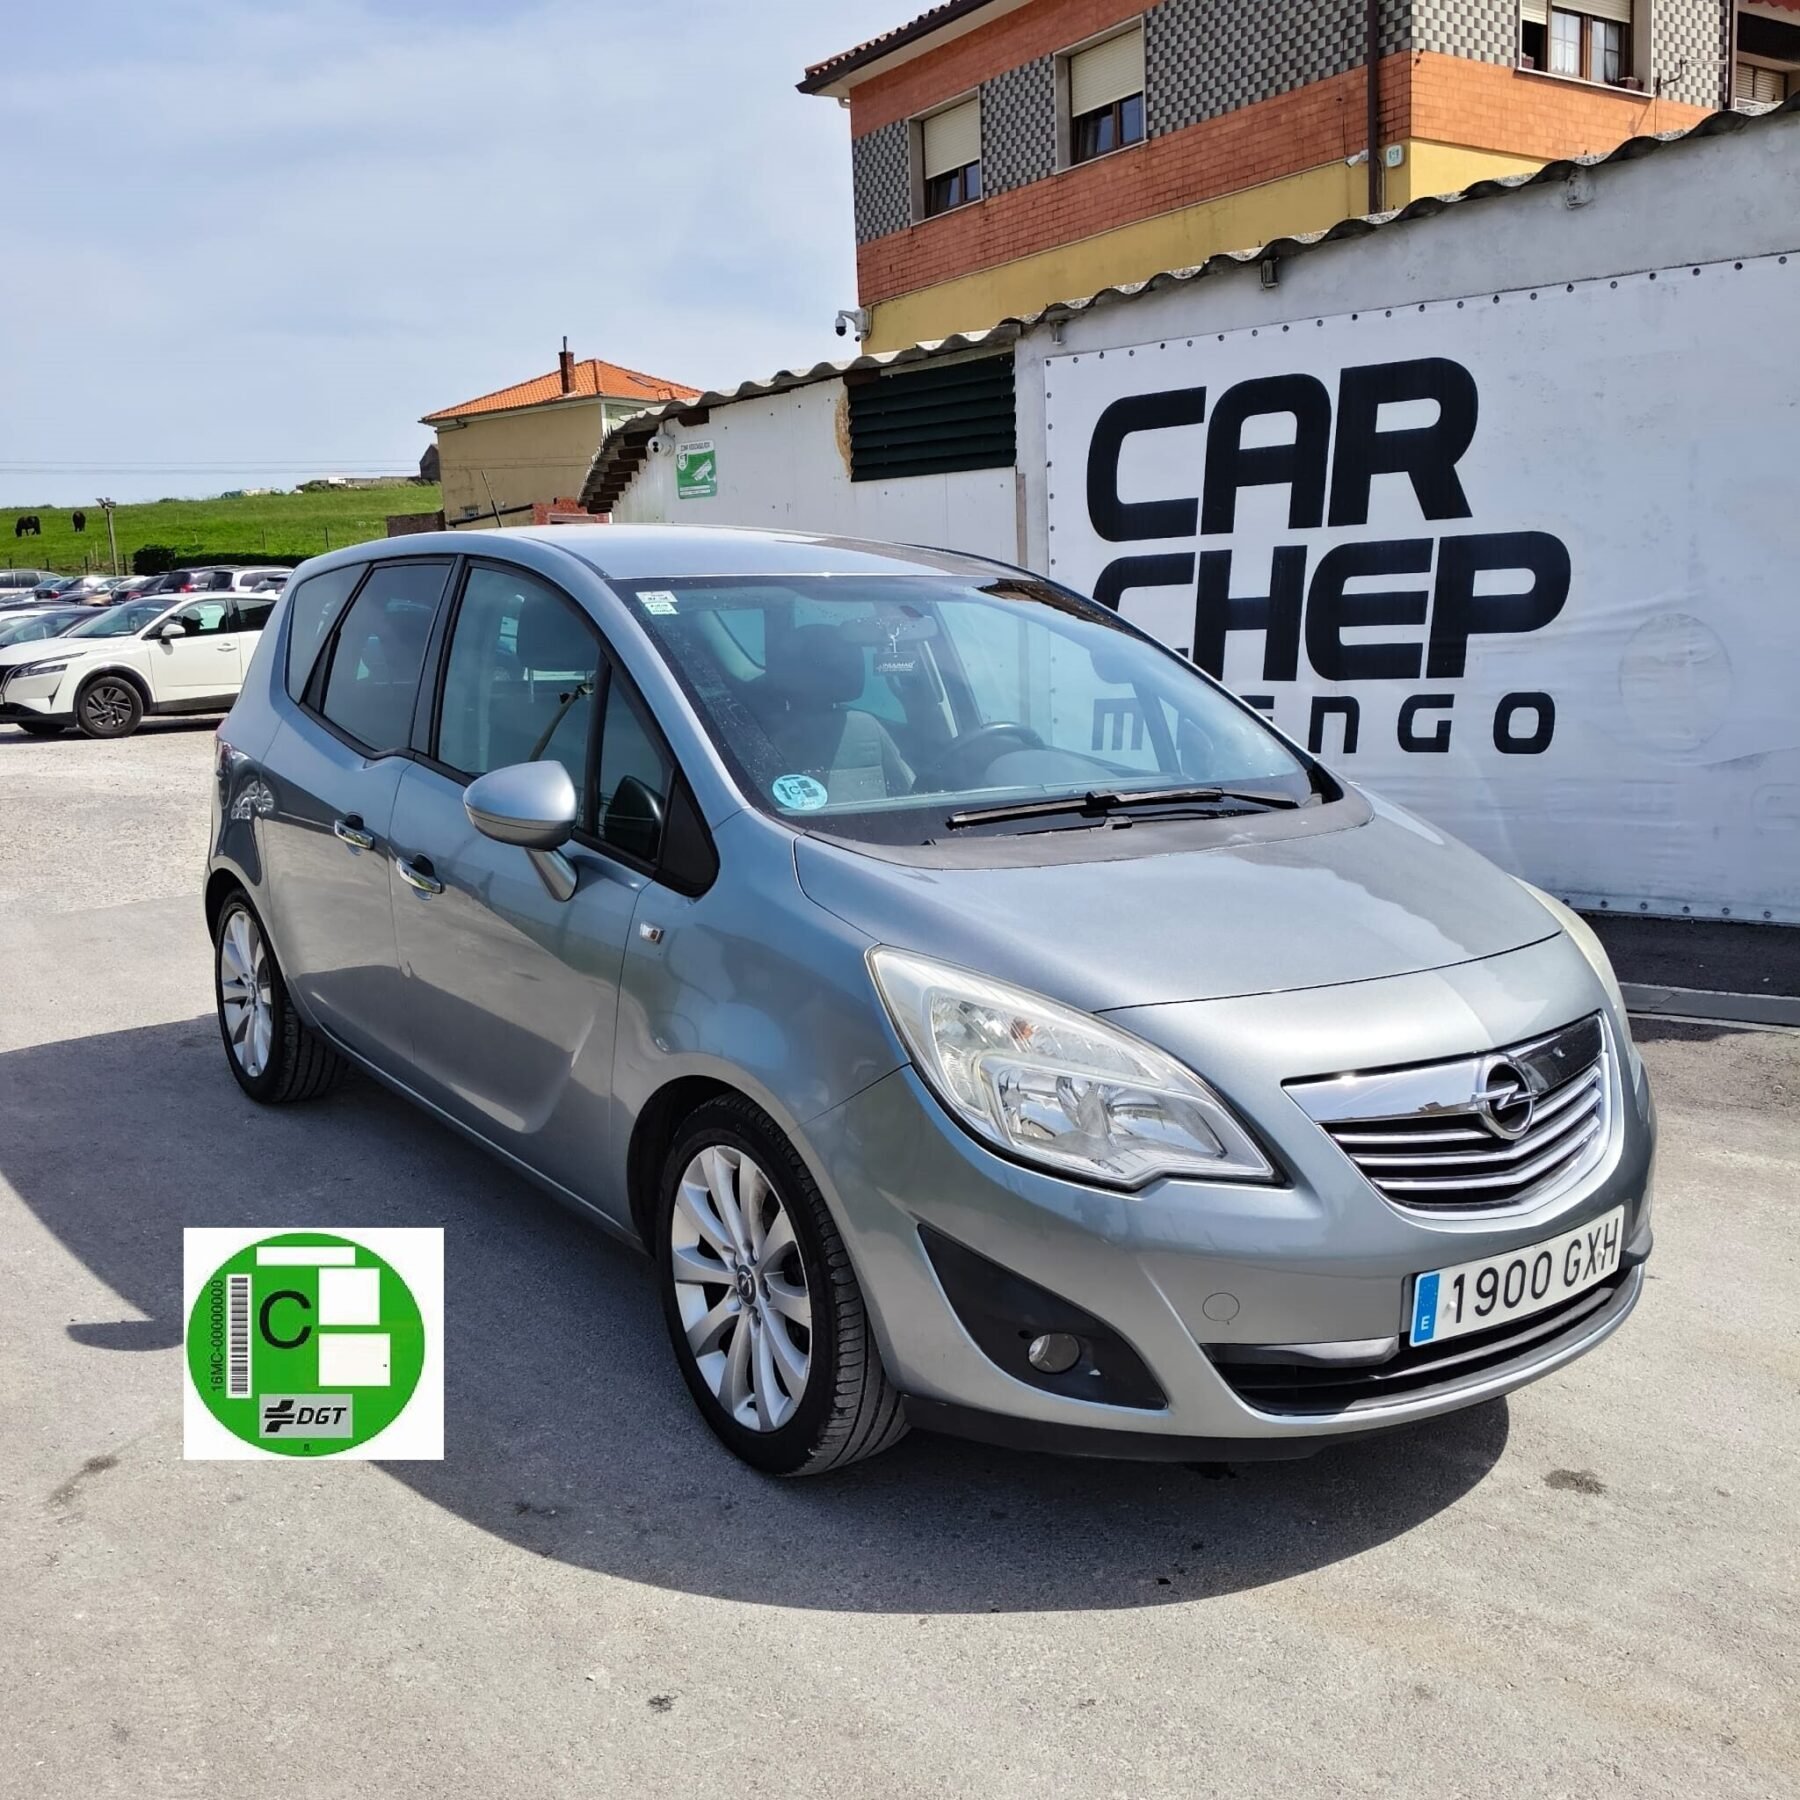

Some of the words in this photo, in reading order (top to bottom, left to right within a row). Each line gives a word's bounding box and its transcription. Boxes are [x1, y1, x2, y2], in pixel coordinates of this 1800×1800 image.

[1086, 357, 1479, 542] CAR
[1421, 1315, 1429, 1330] E
[1453, 1251, 1552, 1323] 1900
[1563, 1218, 1619, 1287] GXH
